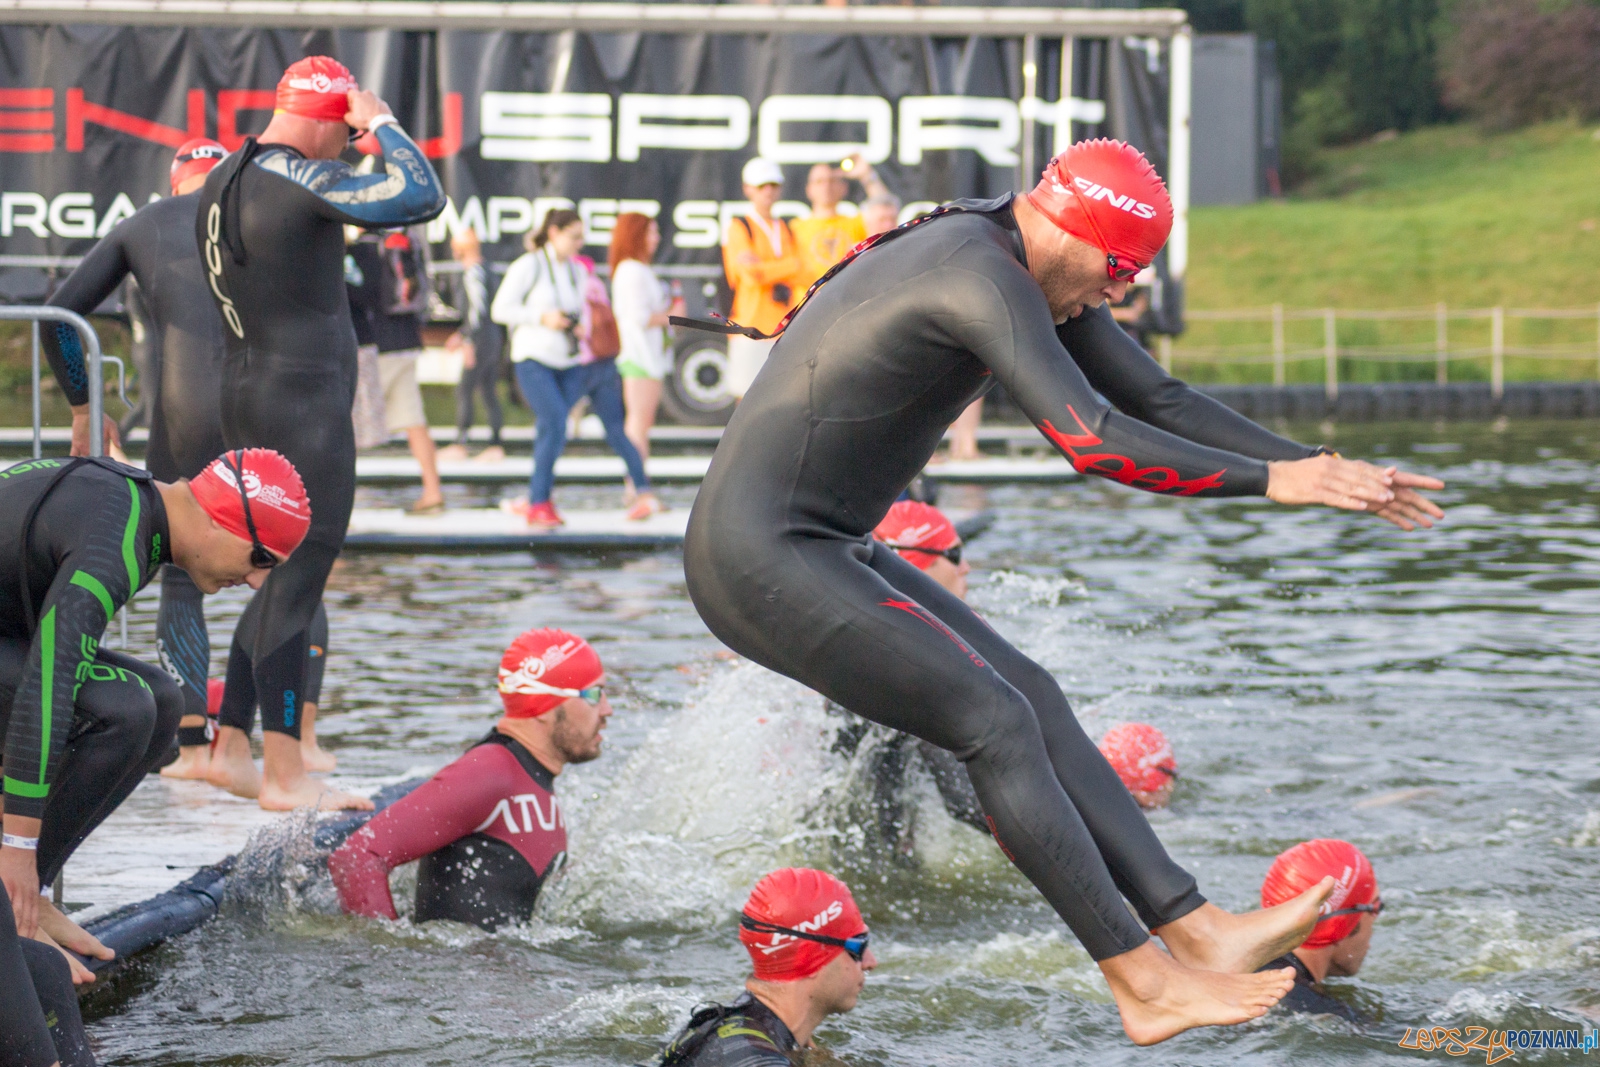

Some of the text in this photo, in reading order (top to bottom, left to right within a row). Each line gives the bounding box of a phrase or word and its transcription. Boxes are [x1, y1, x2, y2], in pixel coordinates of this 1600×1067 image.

[480, 91, 1106, 168] SPORT
[1, 192, 161, 238] RGA
[1073, 176, 1155, 219] FINIS
